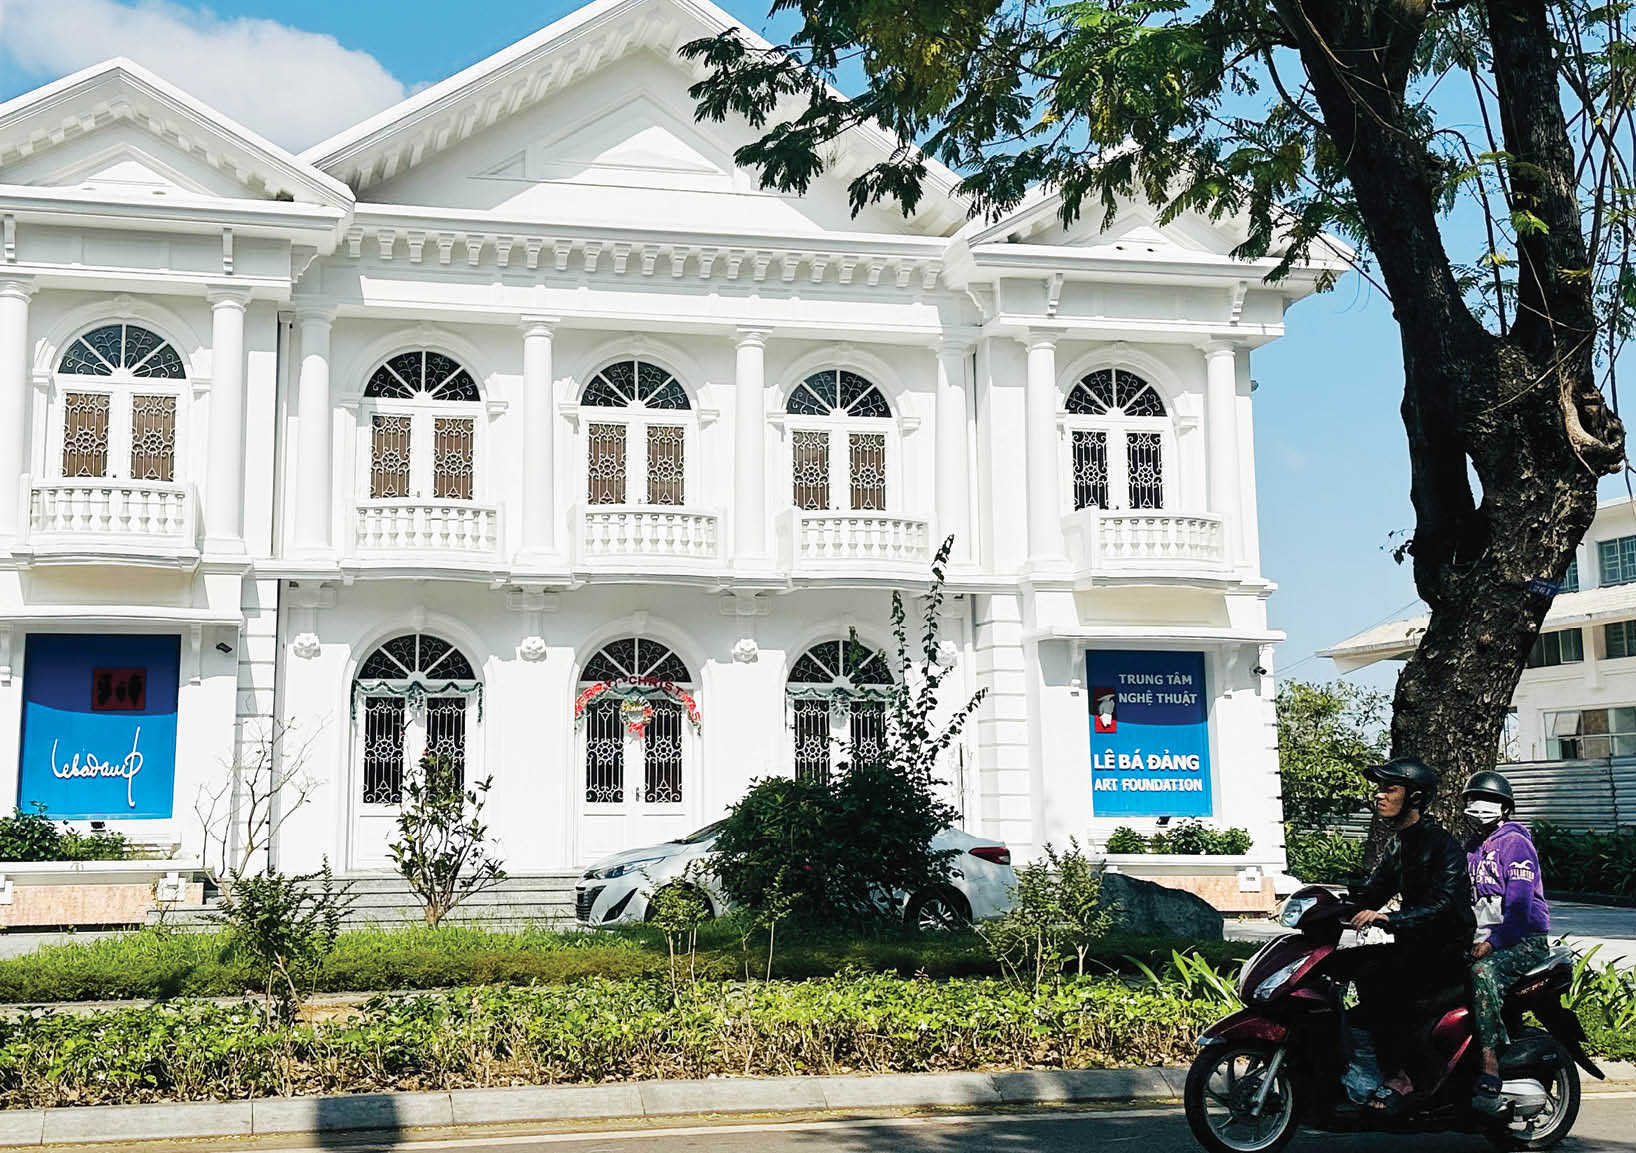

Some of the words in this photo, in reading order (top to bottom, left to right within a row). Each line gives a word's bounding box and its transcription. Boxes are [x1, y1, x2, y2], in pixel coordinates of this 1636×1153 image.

[1119, 674, 1164, 685] TRUNG
[1166, 671, 1192, 685] TÂM
[1118, 690, 1153, 706] NGHỆ
[1156, 691, 1197, 707] THUẬT
[1094, 749, 1115, 770] LÊ
[1118, 749, 1144, 770] BÁ
[1146, 749, 1200, 770] ĐẢNG
[1094, 778, 1118, 792] ART
[1121, 778, 1202, 792] FOUNDATION
